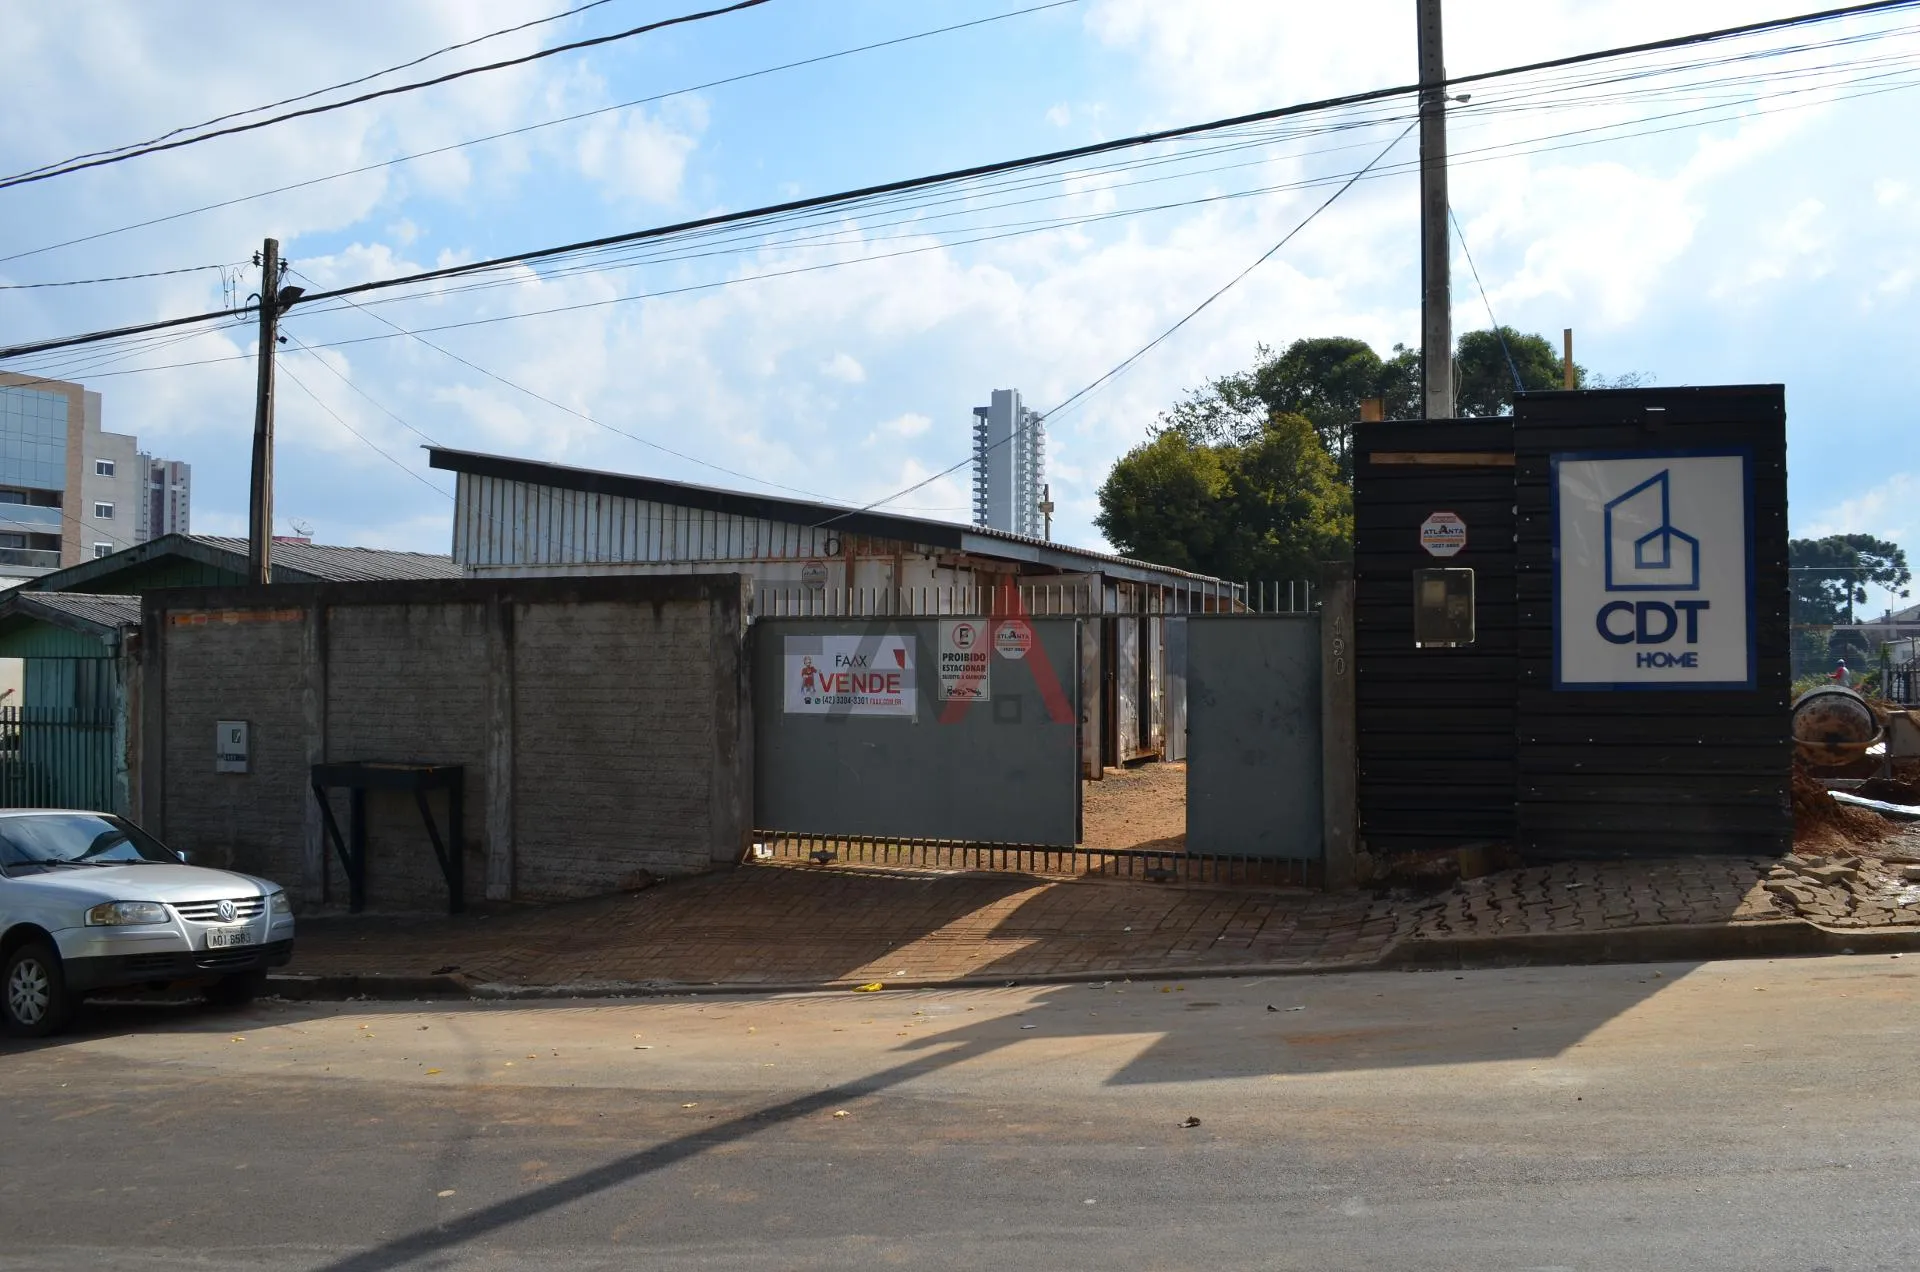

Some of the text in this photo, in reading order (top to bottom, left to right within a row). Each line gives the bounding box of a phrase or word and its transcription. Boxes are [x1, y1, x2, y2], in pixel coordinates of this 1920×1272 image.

[1596, 600, 1710, 645] CDT
[942, 653, 986, 662] PROIBIDO
[1636, 651, 1699, 668] HOME
[942, 664, 986, 672] ESTACIONAR
[819, 673, 901, 694] VENDE
